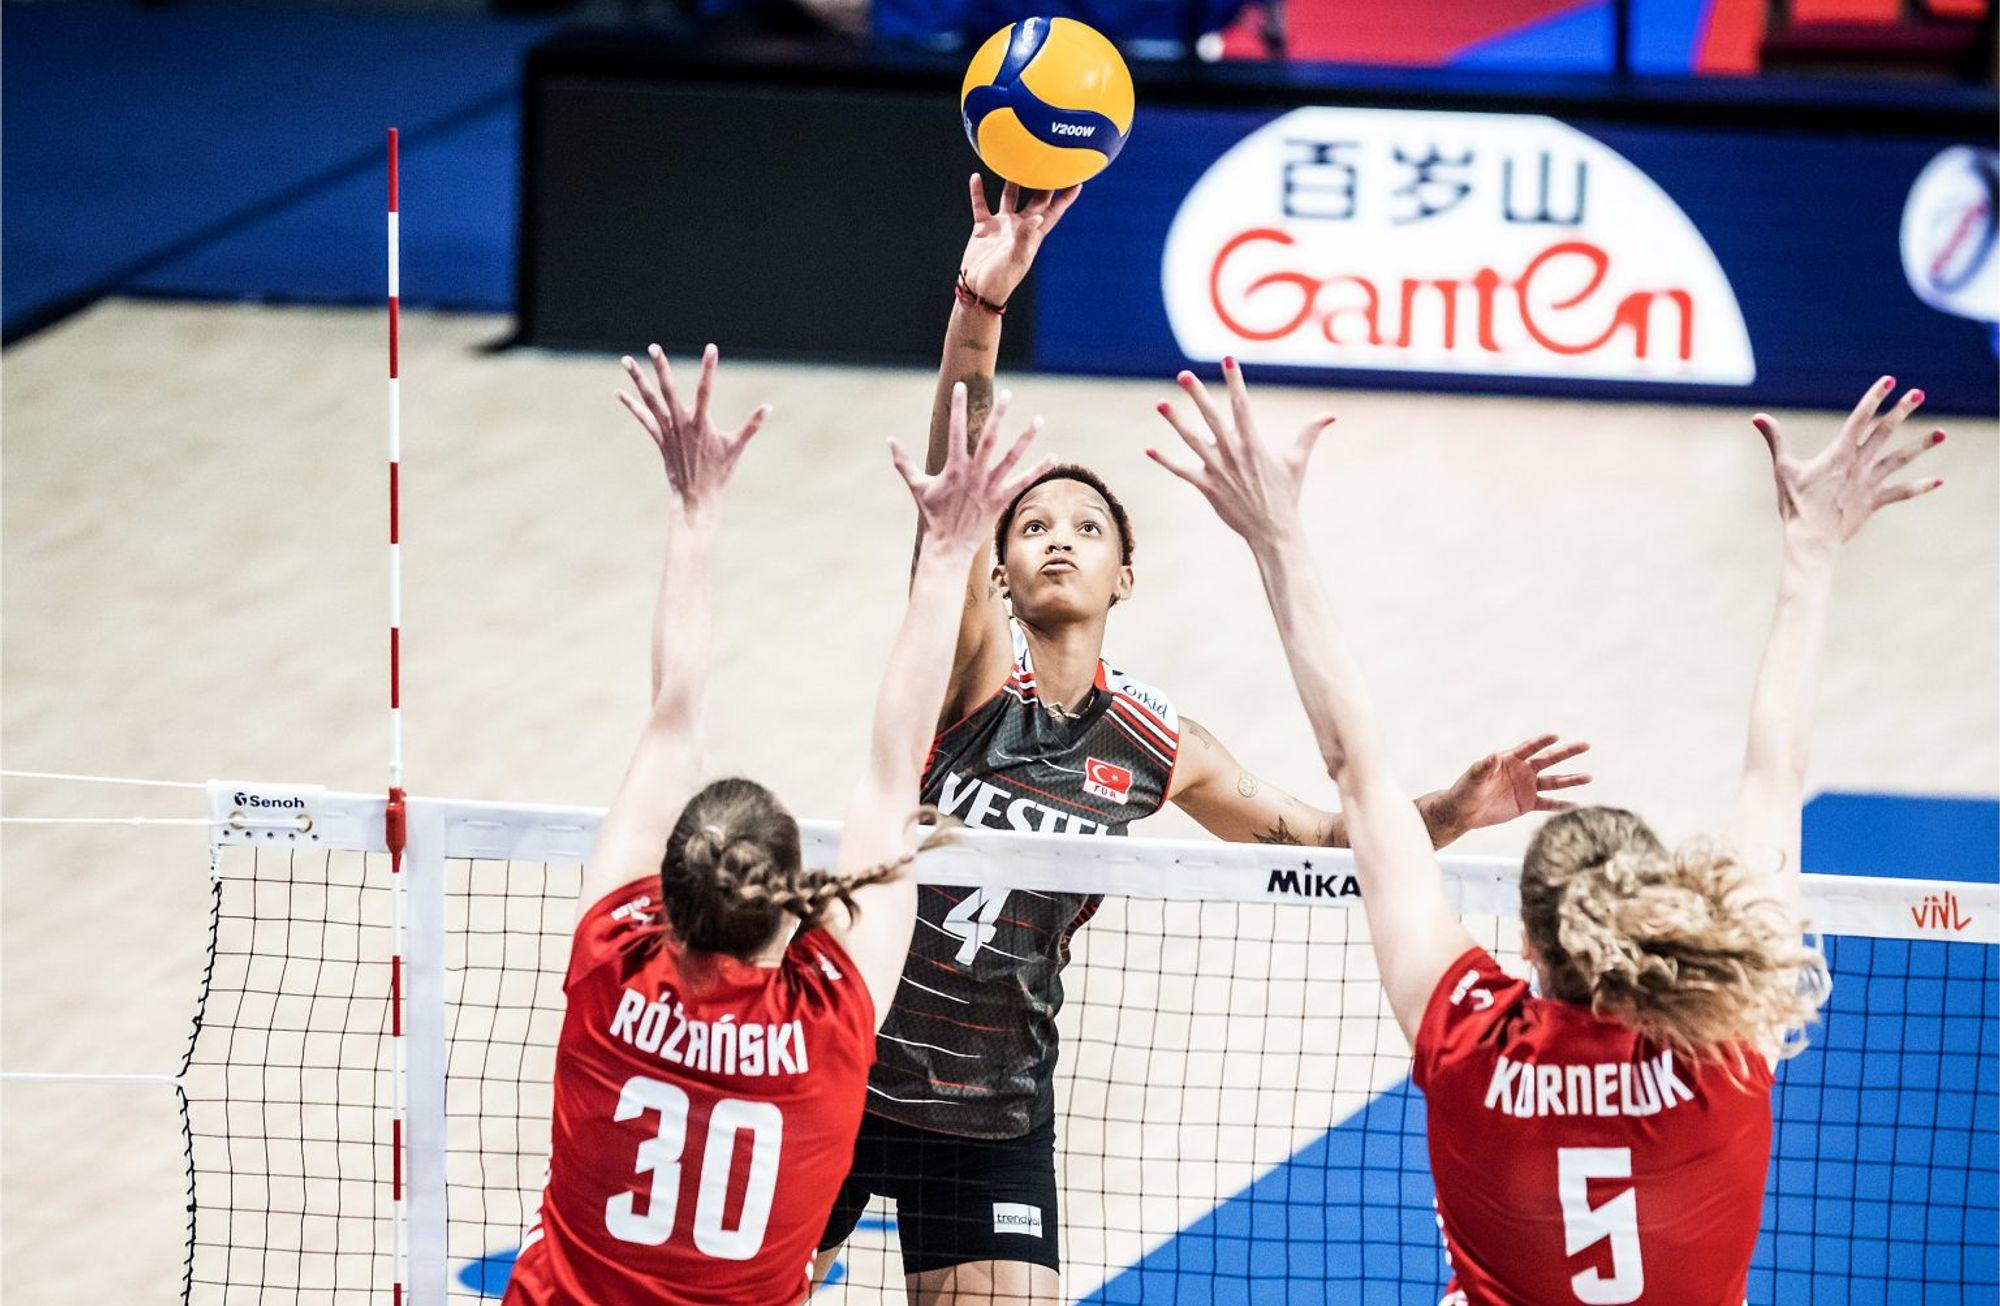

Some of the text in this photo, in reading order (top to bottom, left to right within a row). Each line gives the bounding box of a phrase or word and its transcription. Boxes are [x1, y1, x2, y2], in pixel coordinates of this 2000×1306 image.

[1051, 122, 1095, 137] V200W
[1282, 138, 1587, 225] 百岁山
[250, 794, 305, 809] Senoh
[937, 771, 1109, 836] VEST
[942, 888, 1012, 967] 4
[609, 987, 809, 1077] RÓŻAŃSKI
[604, 1074, 783, 1261] 30
[1557, 1147, 1645, 1305] 5
